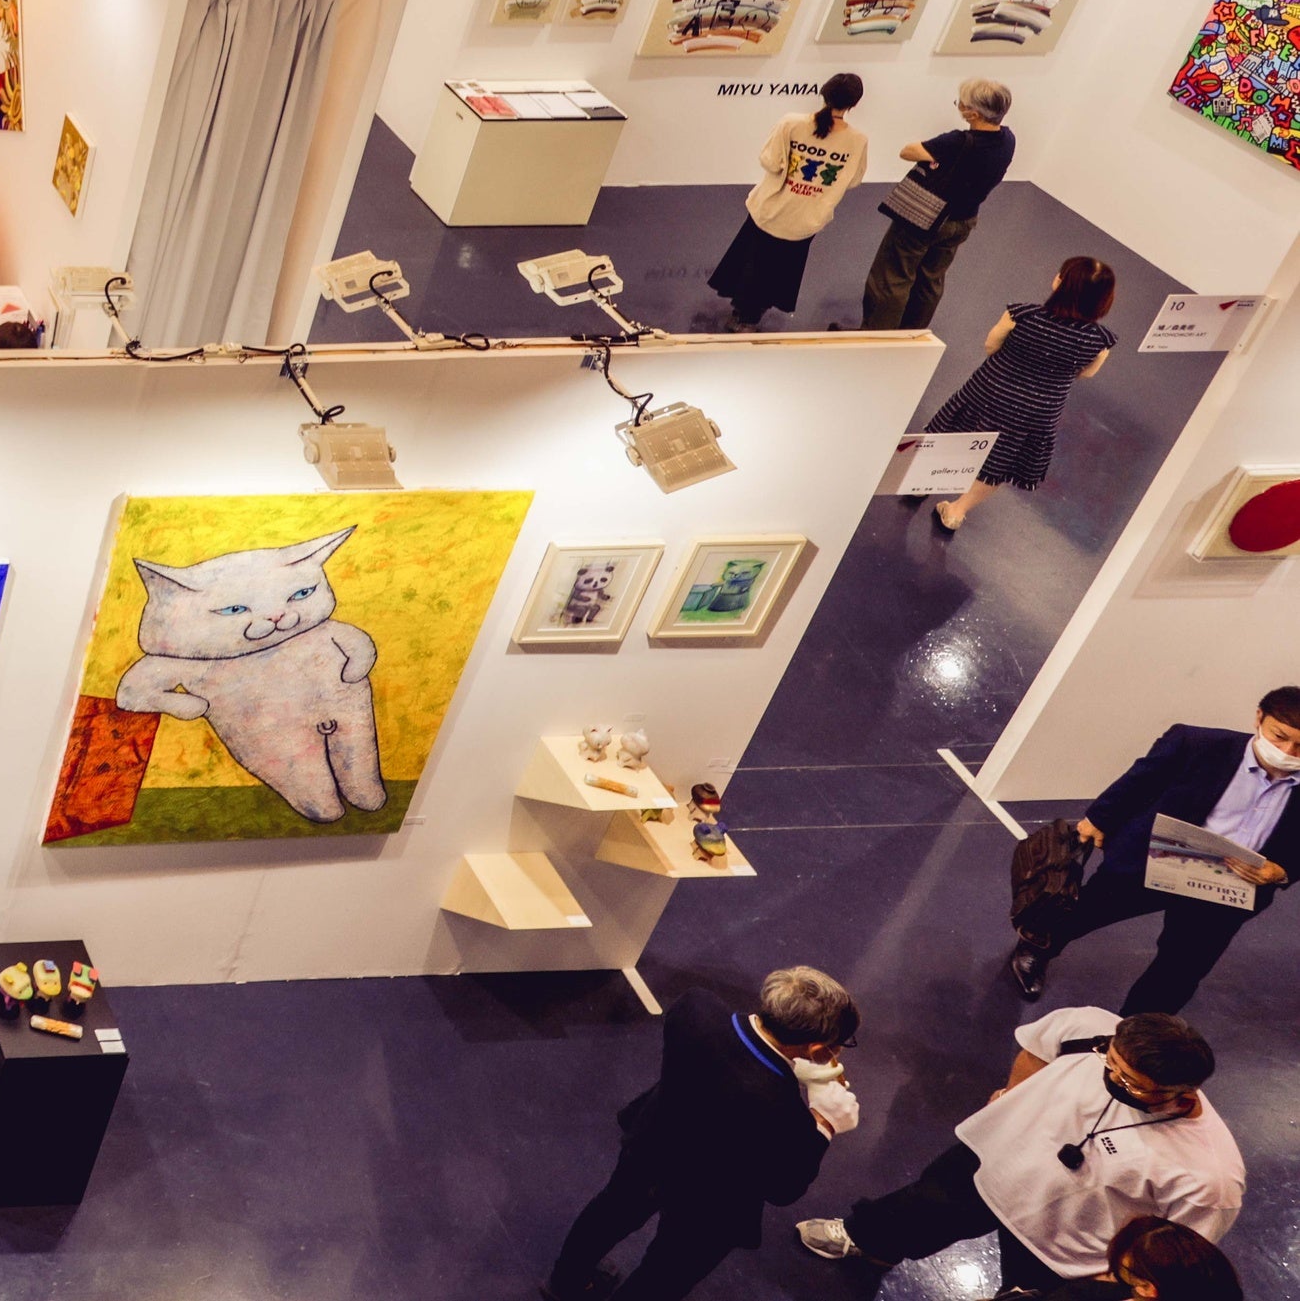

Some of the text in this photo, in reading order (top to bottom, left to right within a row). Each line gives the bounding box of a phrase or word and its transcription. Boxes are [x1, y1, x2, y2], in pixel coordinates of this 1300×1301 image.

[716, 83, 825, 96] MIYU YAMA
[790, 140, 827, 158] GOOD
[790, 187, 813, 198] DEAD
[1169, 301, 1186, 311] 10
[969, 440, 989, 450] 20
[930, 467, 959, 476] gallery
[1186, 881, 1248, 899] TABLOID
[1220, 894, 1248, 906] ART
